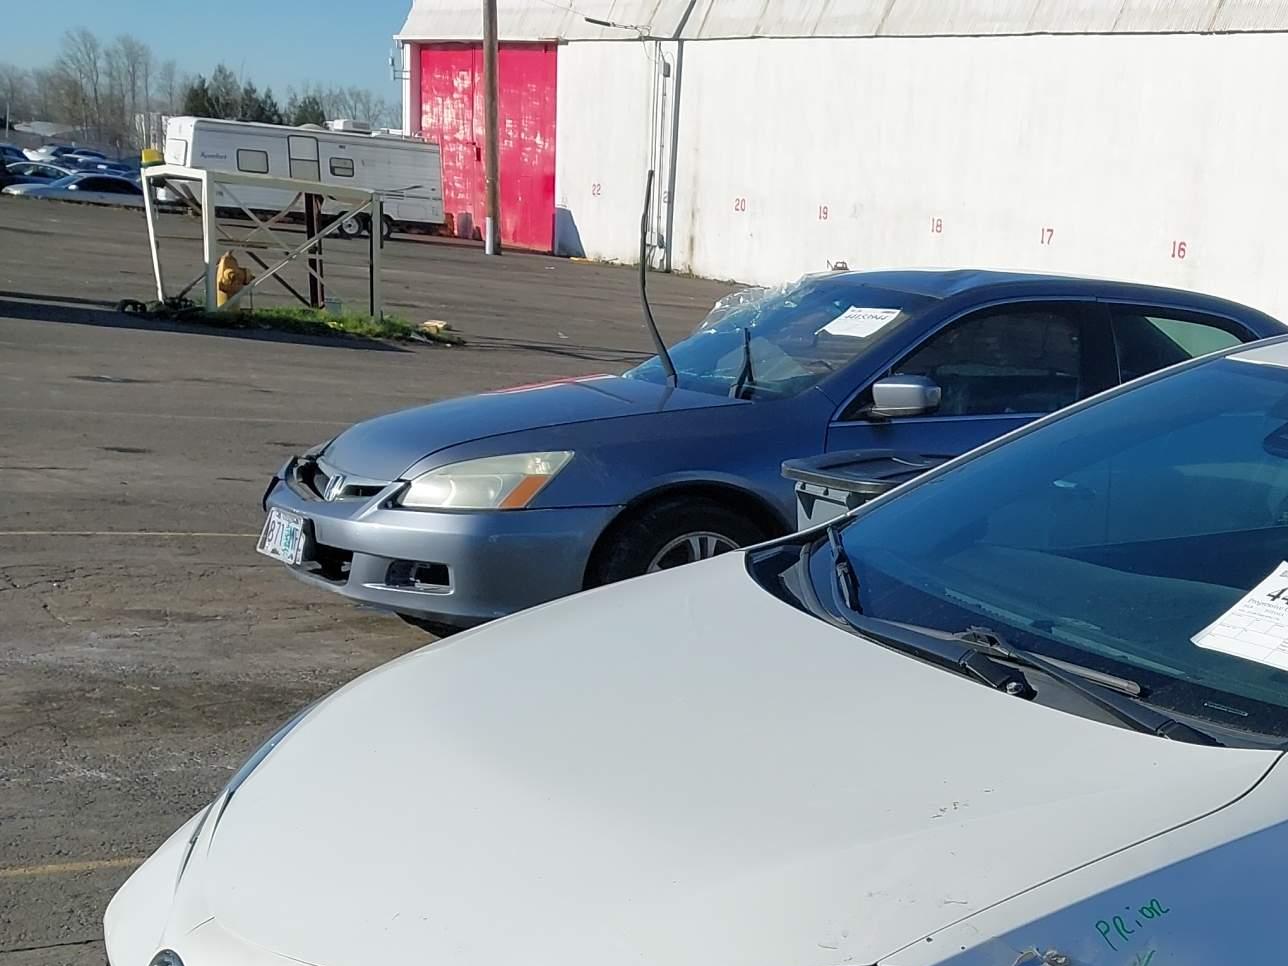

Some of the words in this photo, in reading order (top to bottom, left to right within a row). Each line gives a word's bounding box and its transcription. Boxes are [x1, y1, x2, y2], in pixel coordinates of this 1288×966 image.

[591, 184, 602, 196] 22
[734, 198, 746, 212] 20
[818, 205, 828, 220] 19
[931, 218, 943, 233] 18
[1040, 228, 1054, 245] 17
[1171, 241, 1187, 259] 16
